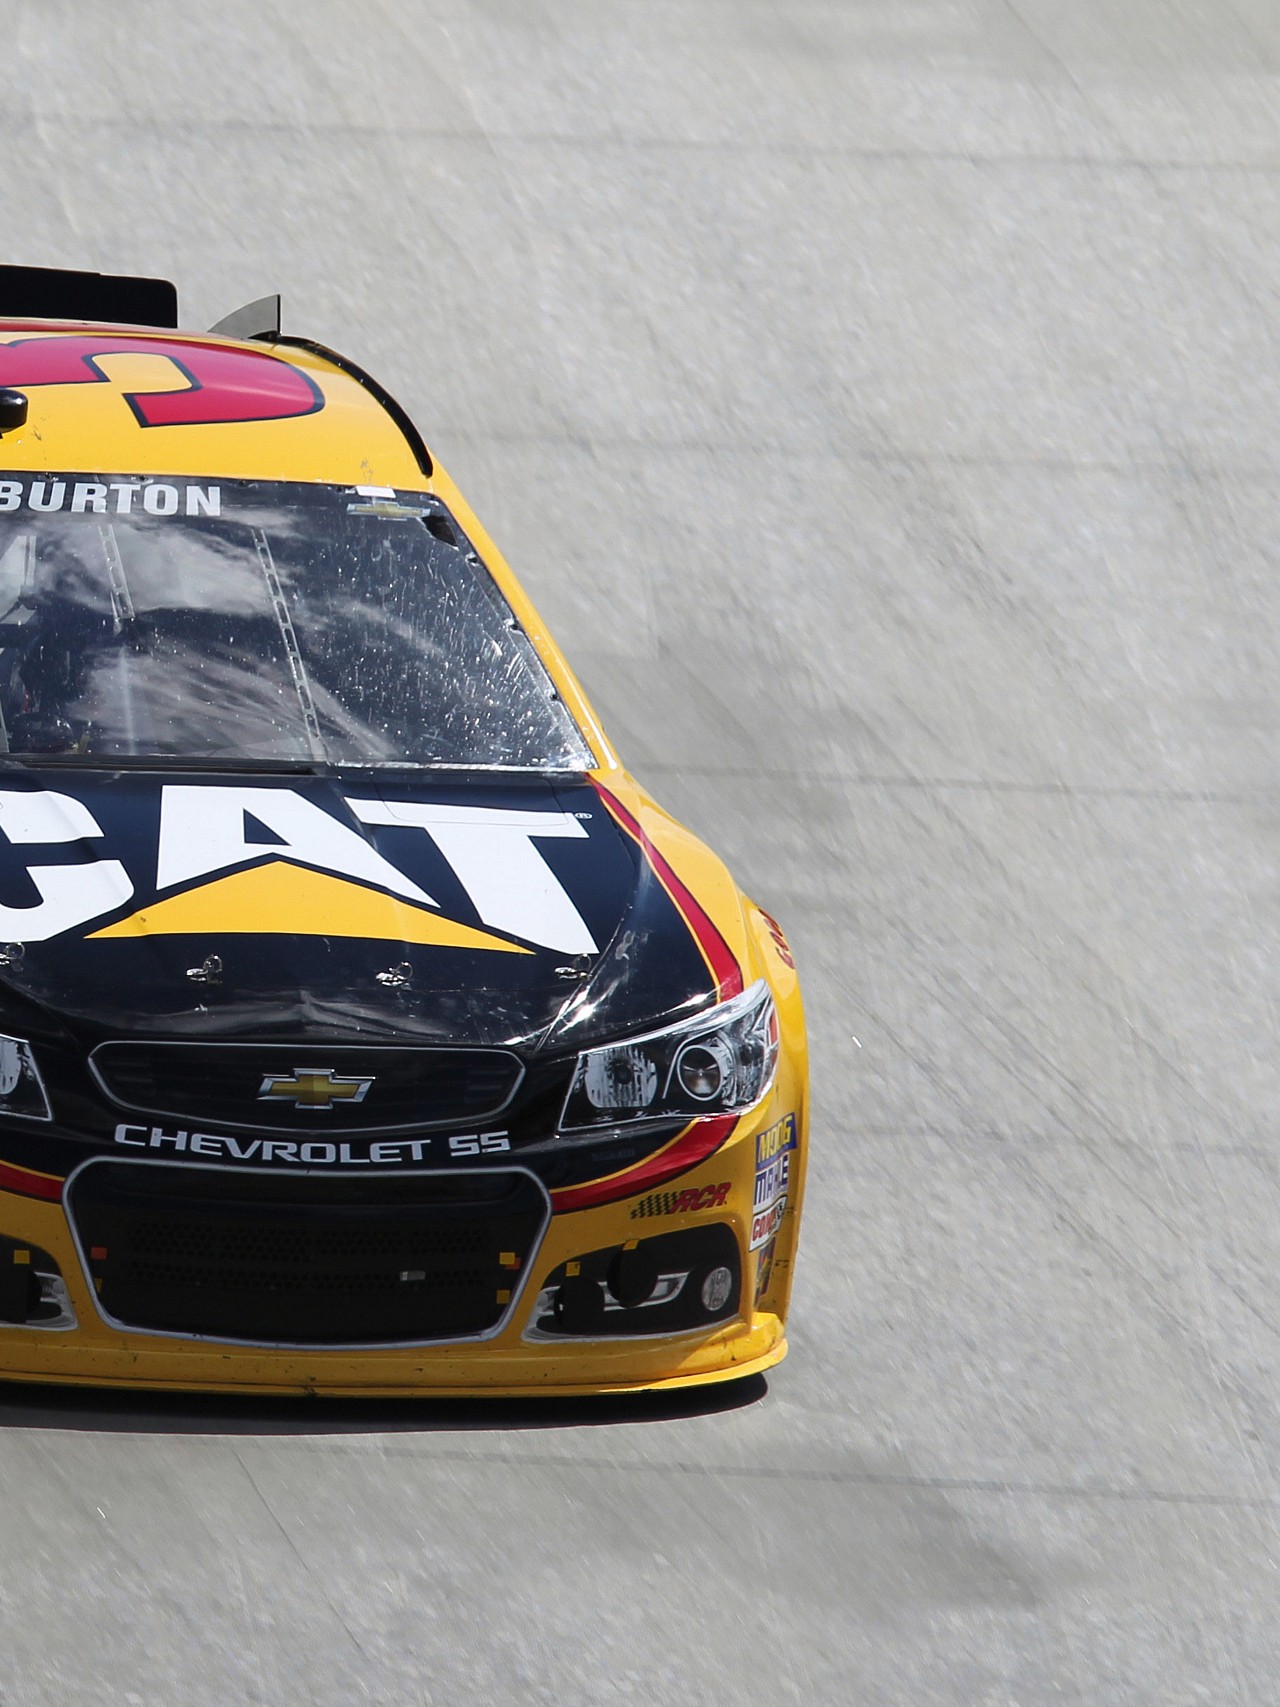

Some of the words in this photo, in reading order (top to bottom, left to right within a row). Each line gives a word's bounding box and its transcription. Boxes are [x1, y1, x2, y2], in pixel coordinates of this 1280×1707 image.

[114, 1123, 431, 1164] CHEVROLET
[449, 1130, 510, 1156] SS
[758, 1116, 793, 1163] MOOG
[669, 1182, 732, 1214] RCR
